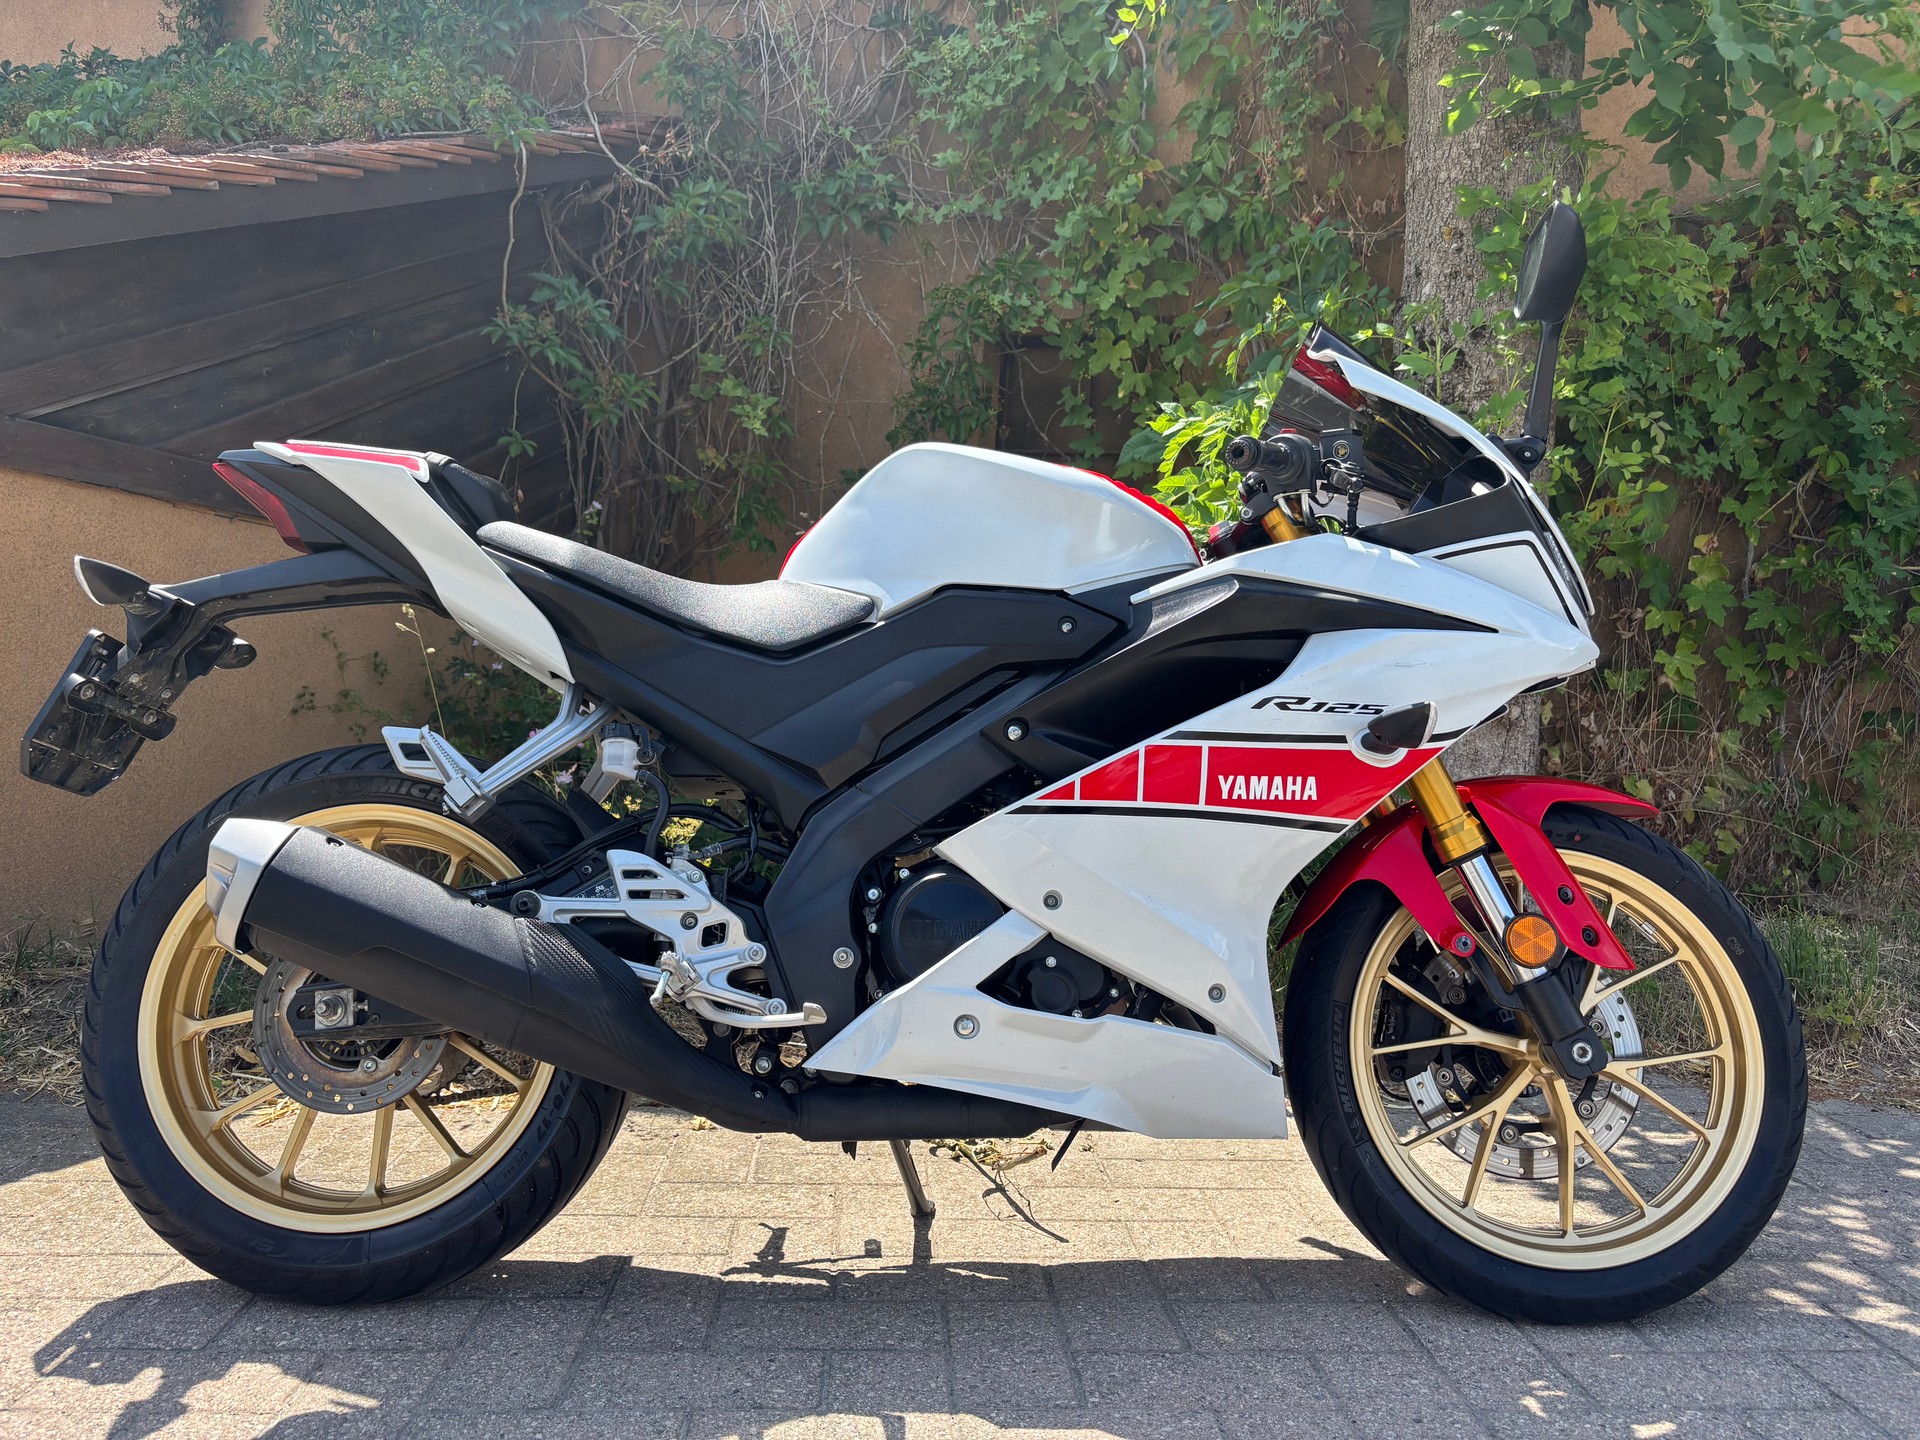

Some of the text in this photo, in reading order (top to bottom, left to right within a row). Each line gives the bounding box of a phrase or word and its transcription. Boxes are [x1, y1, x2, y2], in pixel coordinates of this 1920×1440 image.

[1250, 695, 1391, 716] R125
[371, 777, 445, 802] MICH
[1217, 774, 1318, 801] YAMAHA
[1332, 1008, 1354, 1114] MICHELIN
